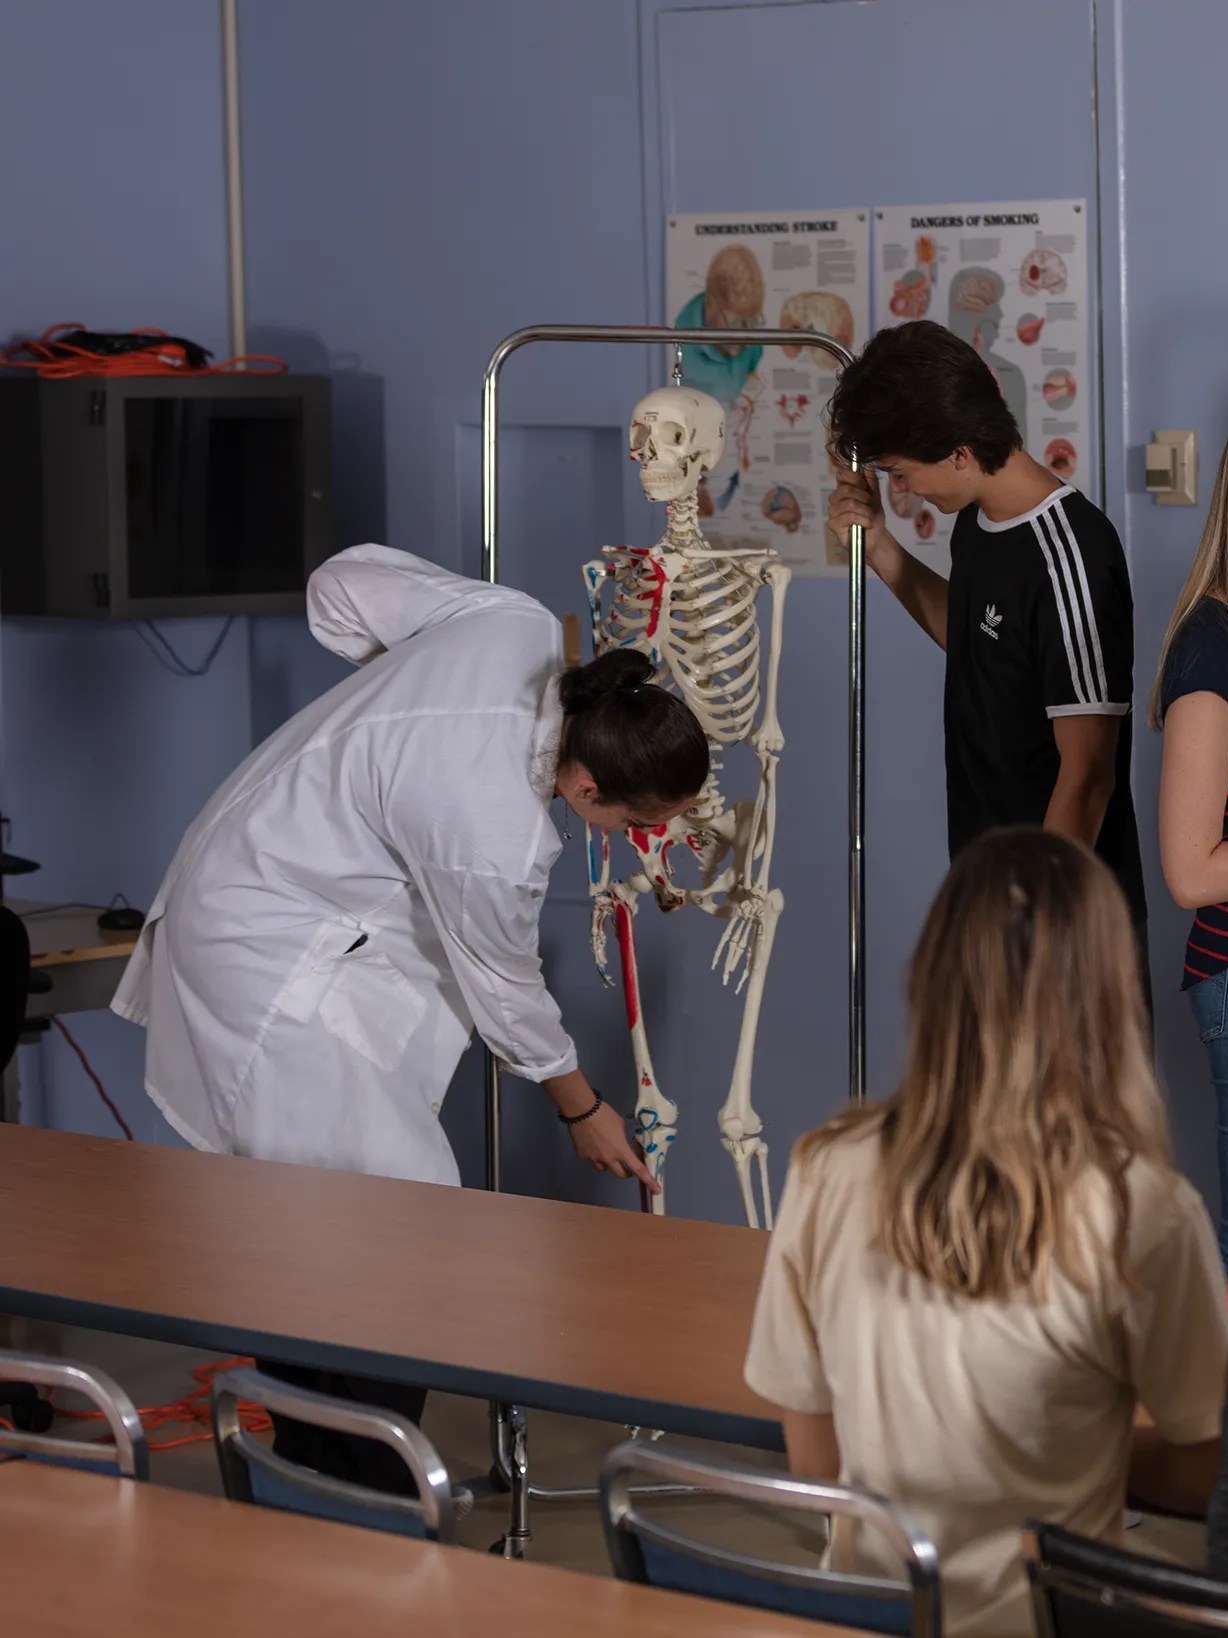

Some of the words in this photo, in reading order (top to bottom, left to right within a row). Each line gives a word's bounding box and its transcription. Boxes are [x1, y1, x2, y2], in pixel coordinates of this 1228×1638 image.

[695, 222, 790, 236] UNDERSTANDING
[793, 220, 838, 233] STROKE
[911, 215, 964, 228] DANGERS
[966, 214, 981, 226] OF
[983, 213, 1039, 225] SMOKING
